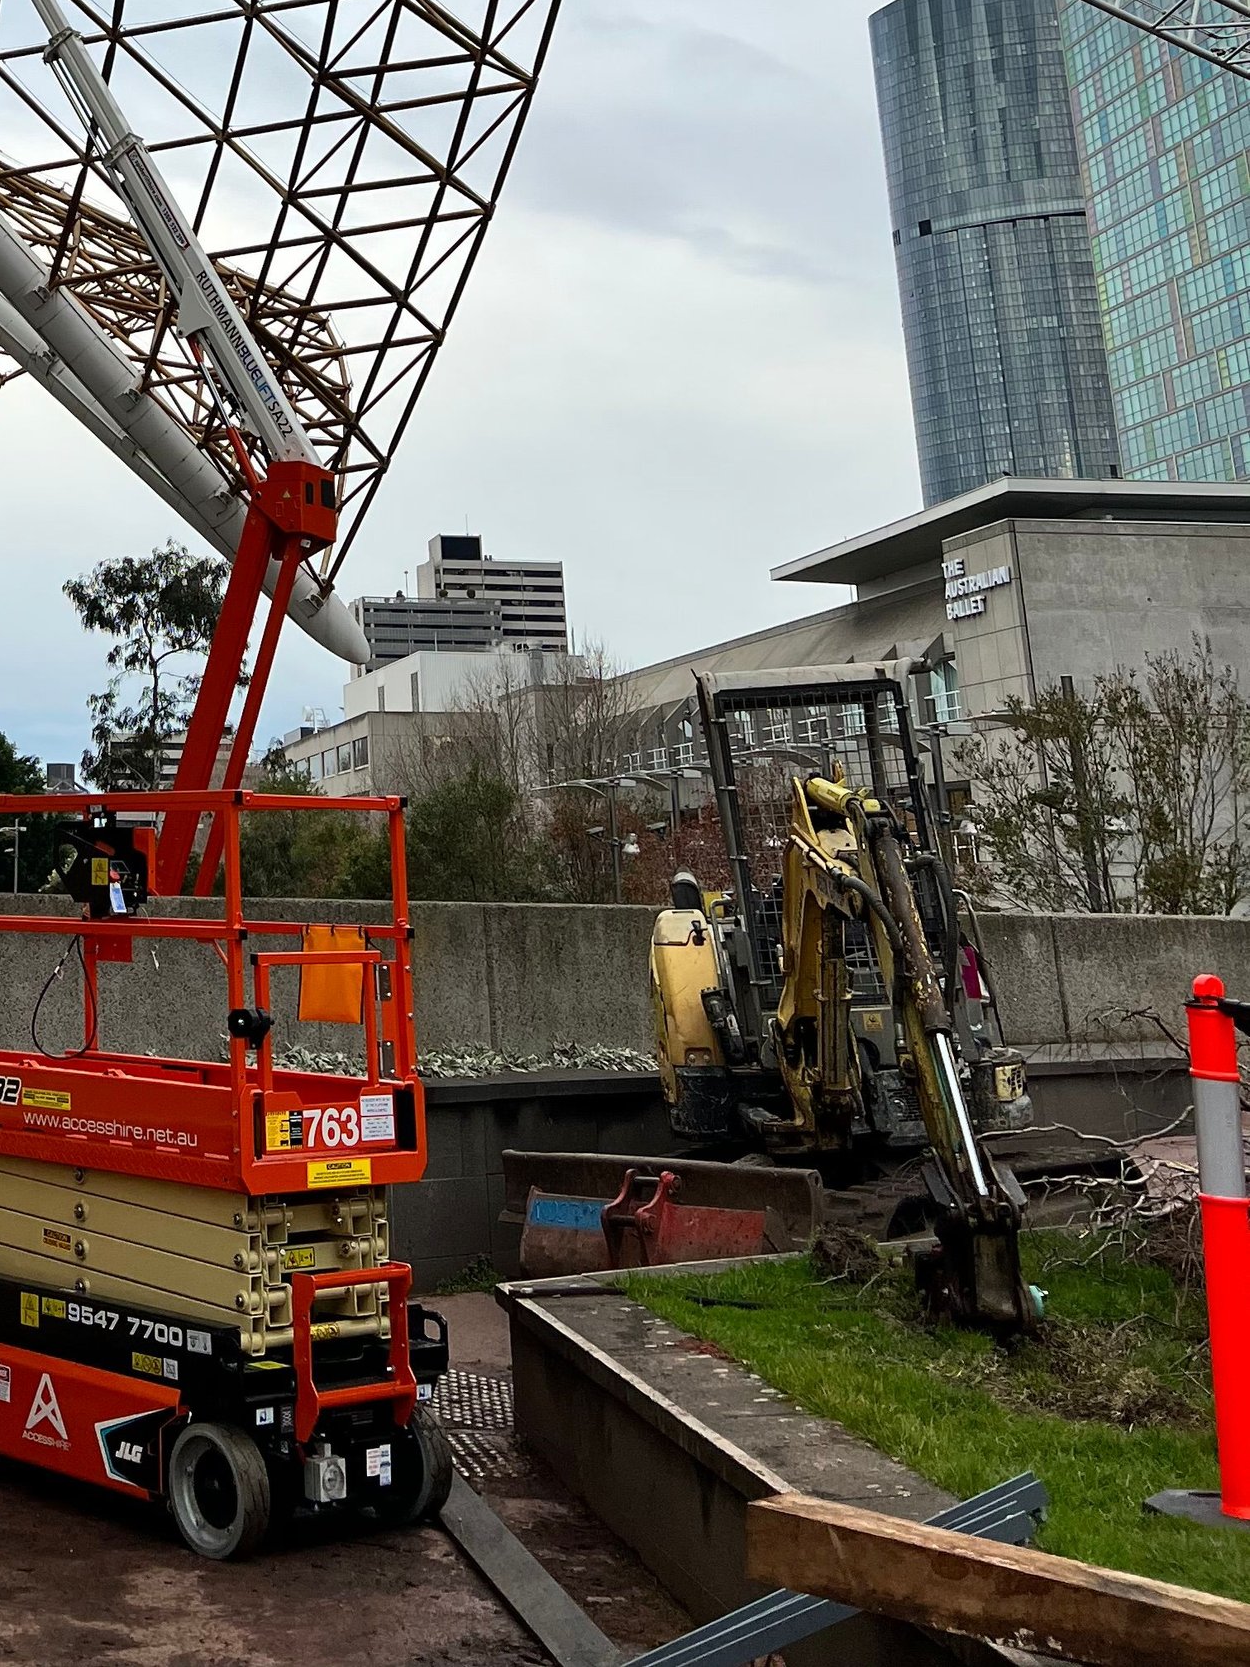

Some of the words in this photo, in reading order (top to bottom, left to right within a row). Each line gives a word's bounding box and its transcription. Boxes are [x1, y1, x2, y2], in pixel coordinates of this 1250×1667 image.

[941, 558, 965, 579] THE
[945, 566, 1011, 600] AUSTRALIAN
[946, 595, 986, 621] BALLET
[23, 1112, 198, 1147] www.accesshire.net.au
[302, 1107, 360, 1148] 763
[68, 1303, 120, 1331] 9547
[127, 1316, 183, 1347] 7700
[22, 1430, 70, 1452] ACCESSHIRE
[115, 1441, 143, 1464] JLG
